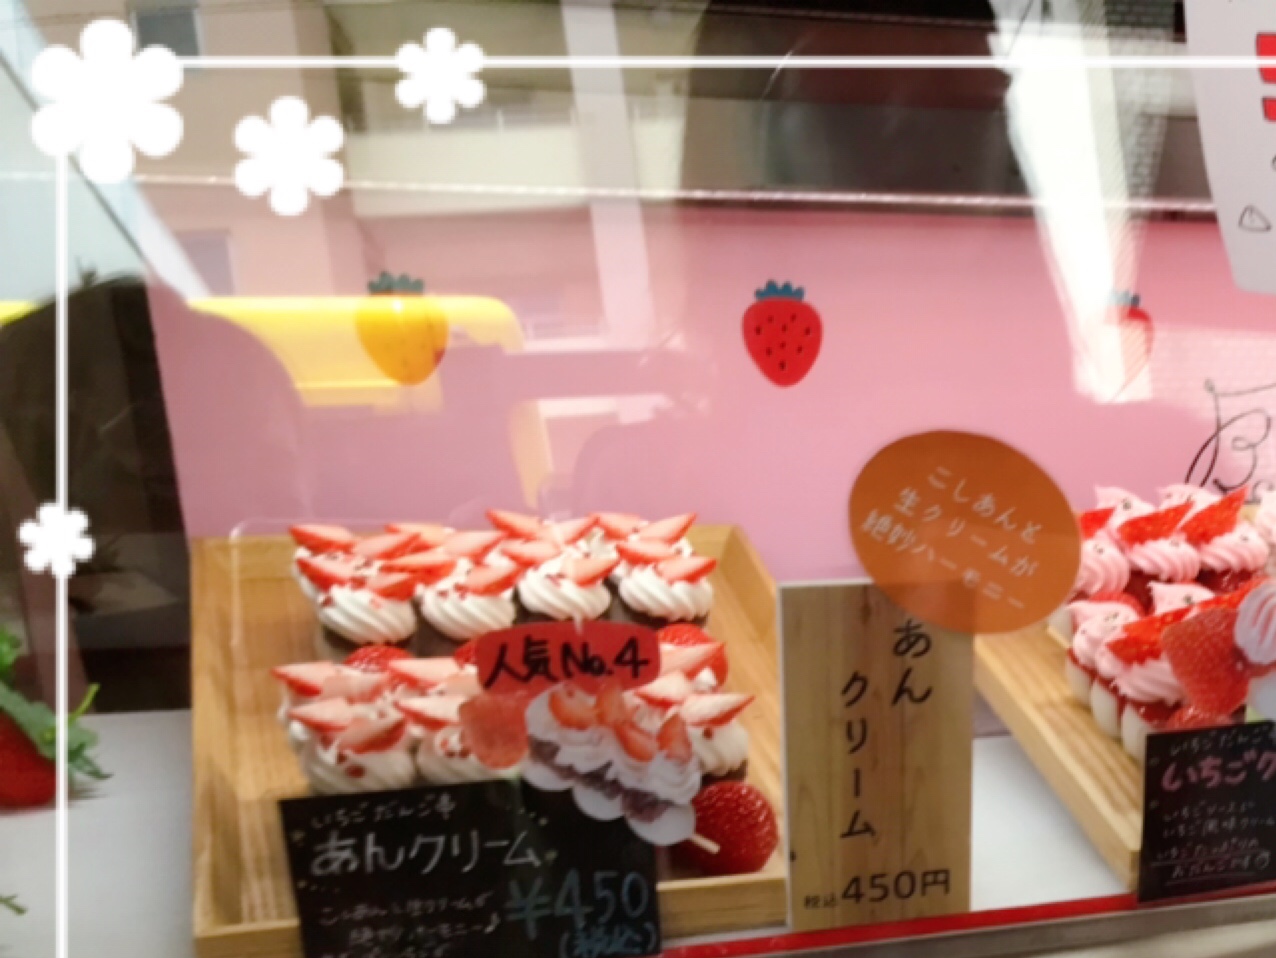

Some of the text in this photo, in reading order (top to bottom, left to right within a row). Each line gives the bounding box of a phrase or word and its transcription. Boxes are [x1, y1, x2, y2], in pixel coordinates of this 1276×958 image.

[893, 486, 1040, 578] 生クリームが
[926, 465, 1043, 545] こしあんと
[861, 507, 1026, 610] 絶妙ハーモニー
[485, 638, 650, 688] 人気No.4
[891, 619, 934, 706] あん
[840, 669, 877, 840] クリーム
[309, 828, 542, 878] あんクリーム
[505, 868, 651, 940] ¥450
